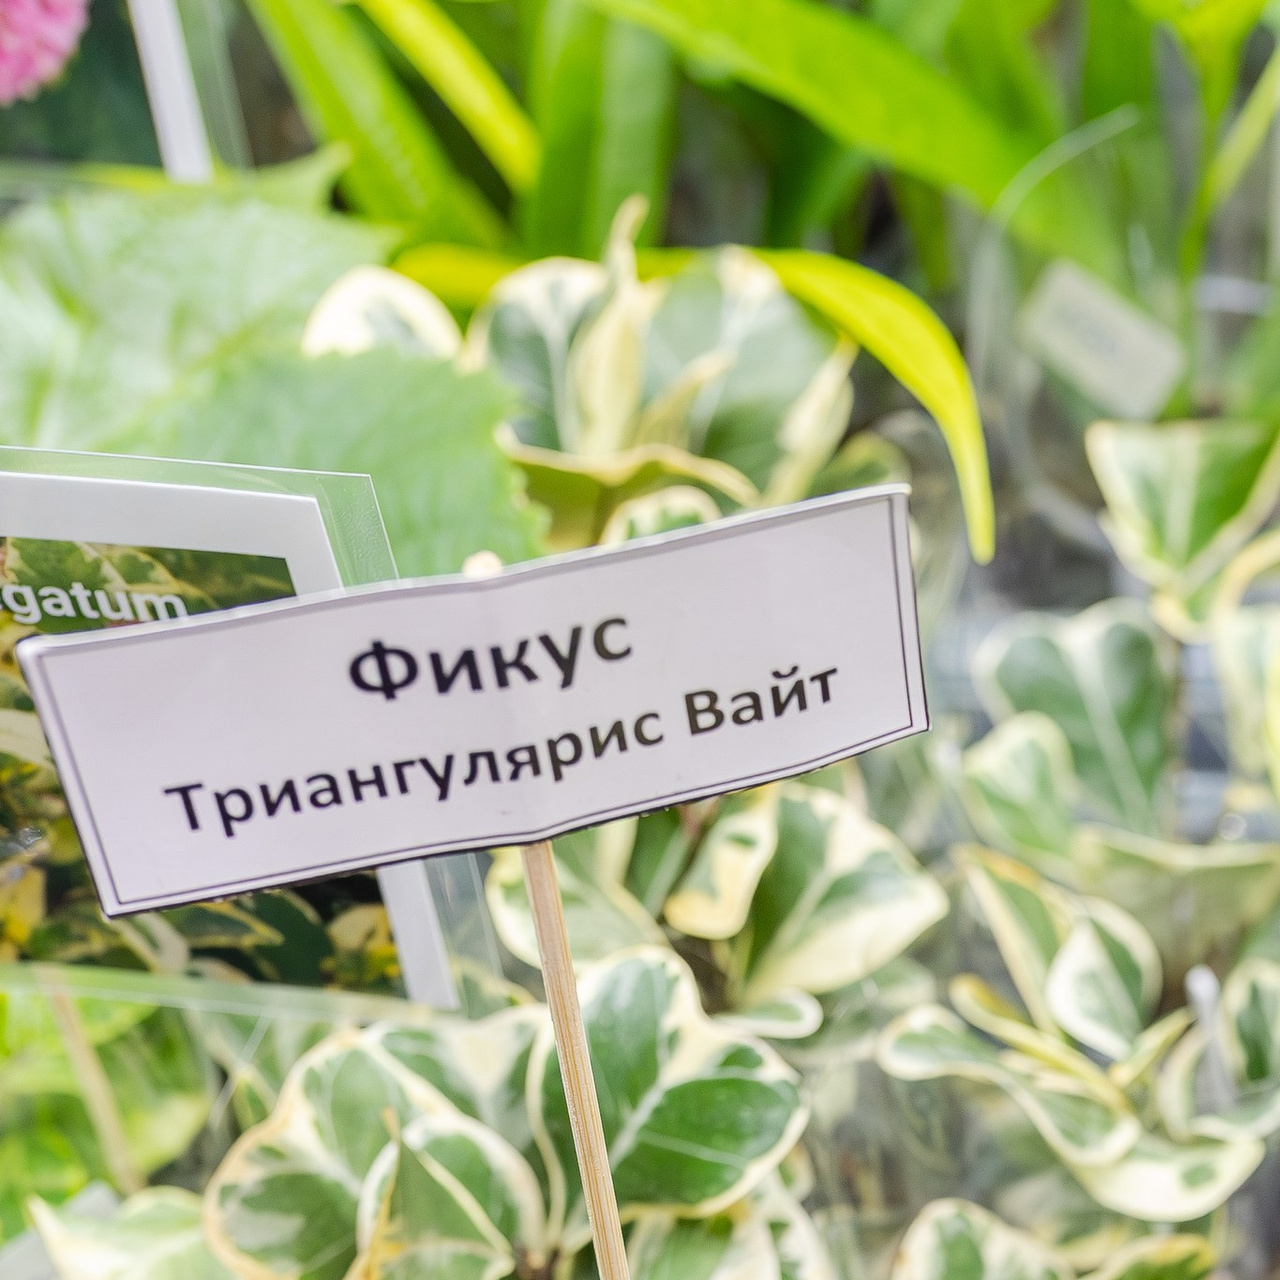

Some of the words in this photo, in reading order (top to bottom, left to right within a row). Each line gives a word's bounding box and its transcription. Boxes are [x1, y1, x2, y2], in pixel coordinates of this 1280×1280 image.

[0, 581, 188, 625] gatum
[348, 617, 632, 701] Фикус
[163, 712, 664, 838] Триангулярис
[684, 665, 838, 736] Вайт
